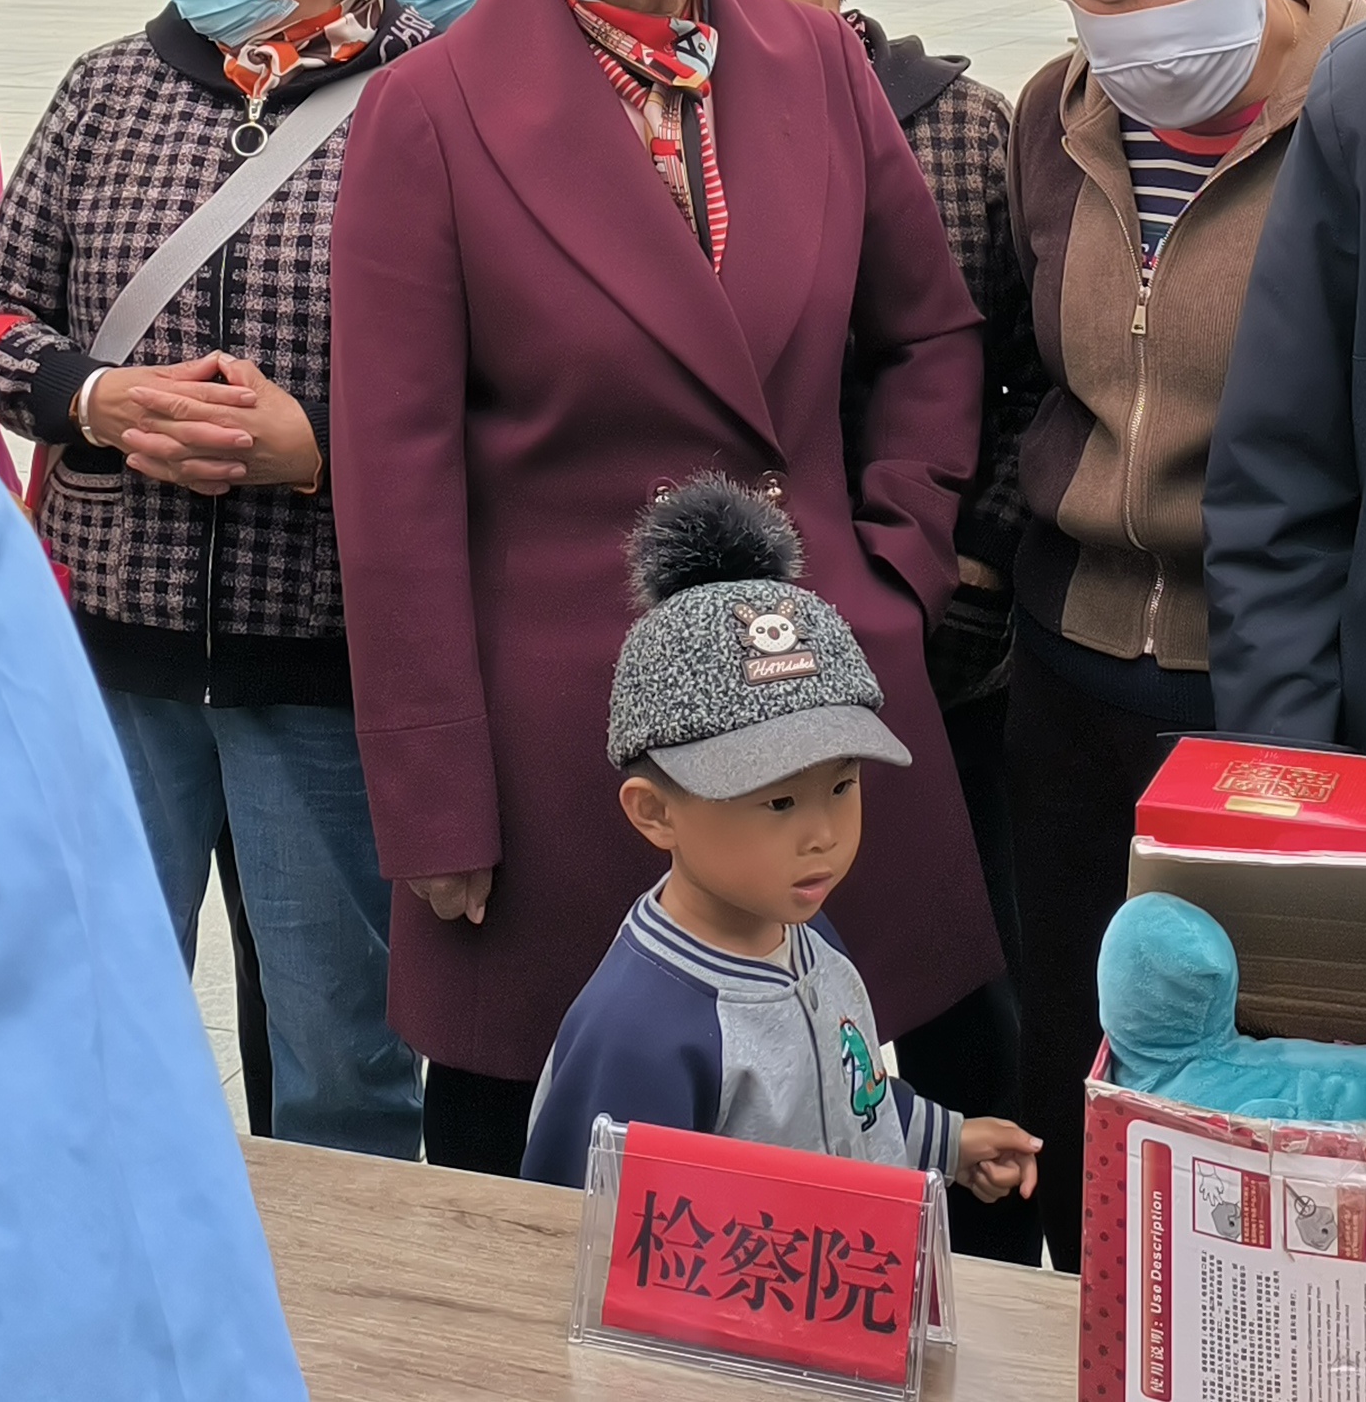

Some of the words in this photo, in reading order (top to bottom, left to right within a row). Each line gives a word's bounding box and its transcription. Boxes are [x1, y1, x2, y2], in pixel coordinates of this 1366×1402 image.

[627, 1190, 901, 1334] 检察院
[1150, 1190, 1165, 1280] Description
[1151, 1285, 1163, 1313] Use
